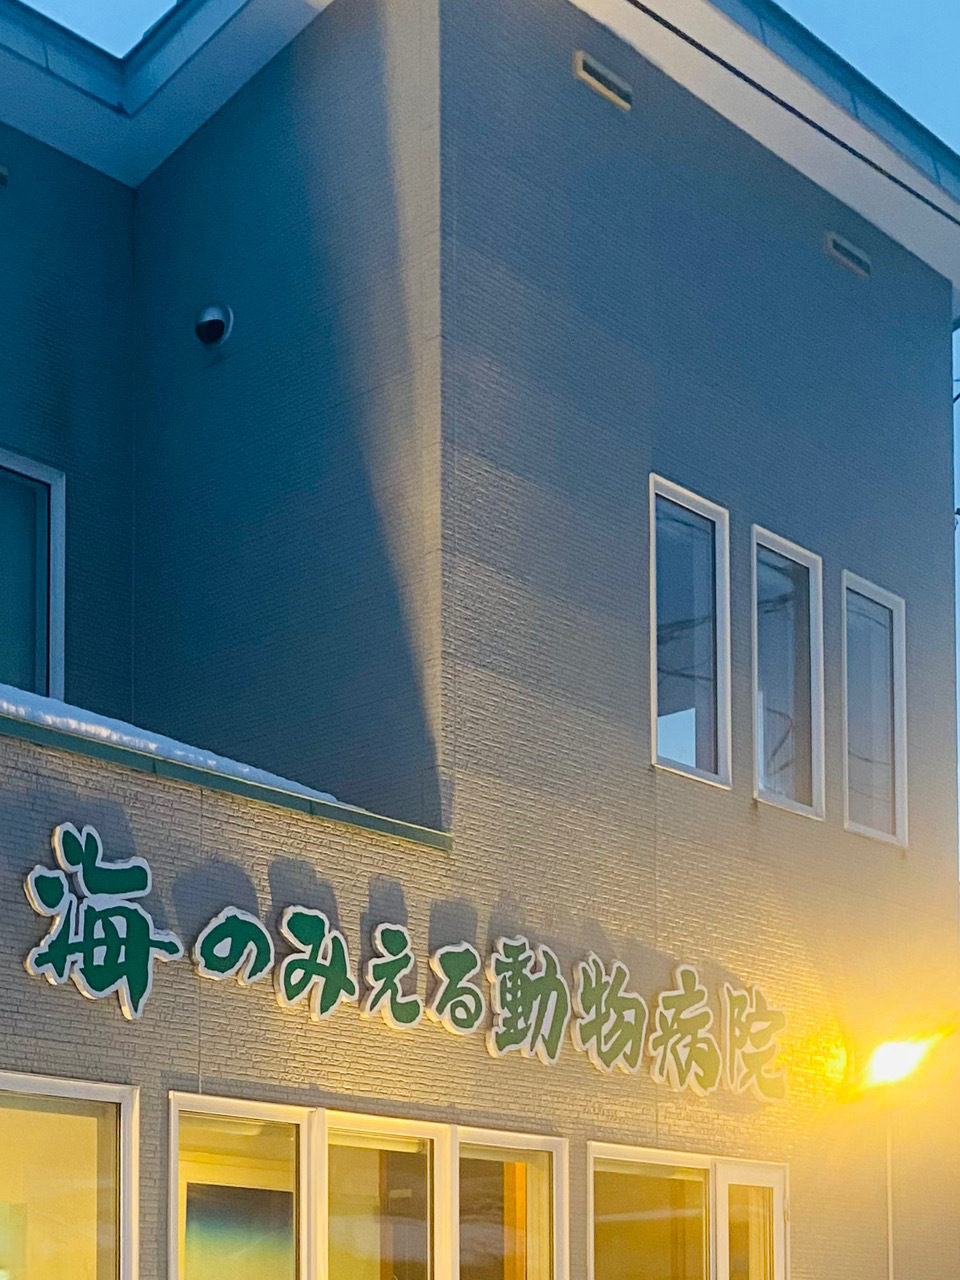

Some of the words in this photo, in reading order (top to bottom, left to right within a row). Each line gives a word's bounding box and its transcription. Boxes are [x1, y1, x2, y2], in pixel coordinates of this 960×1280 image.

[29, 824, 787, 1100] 海のみえる動物病院
